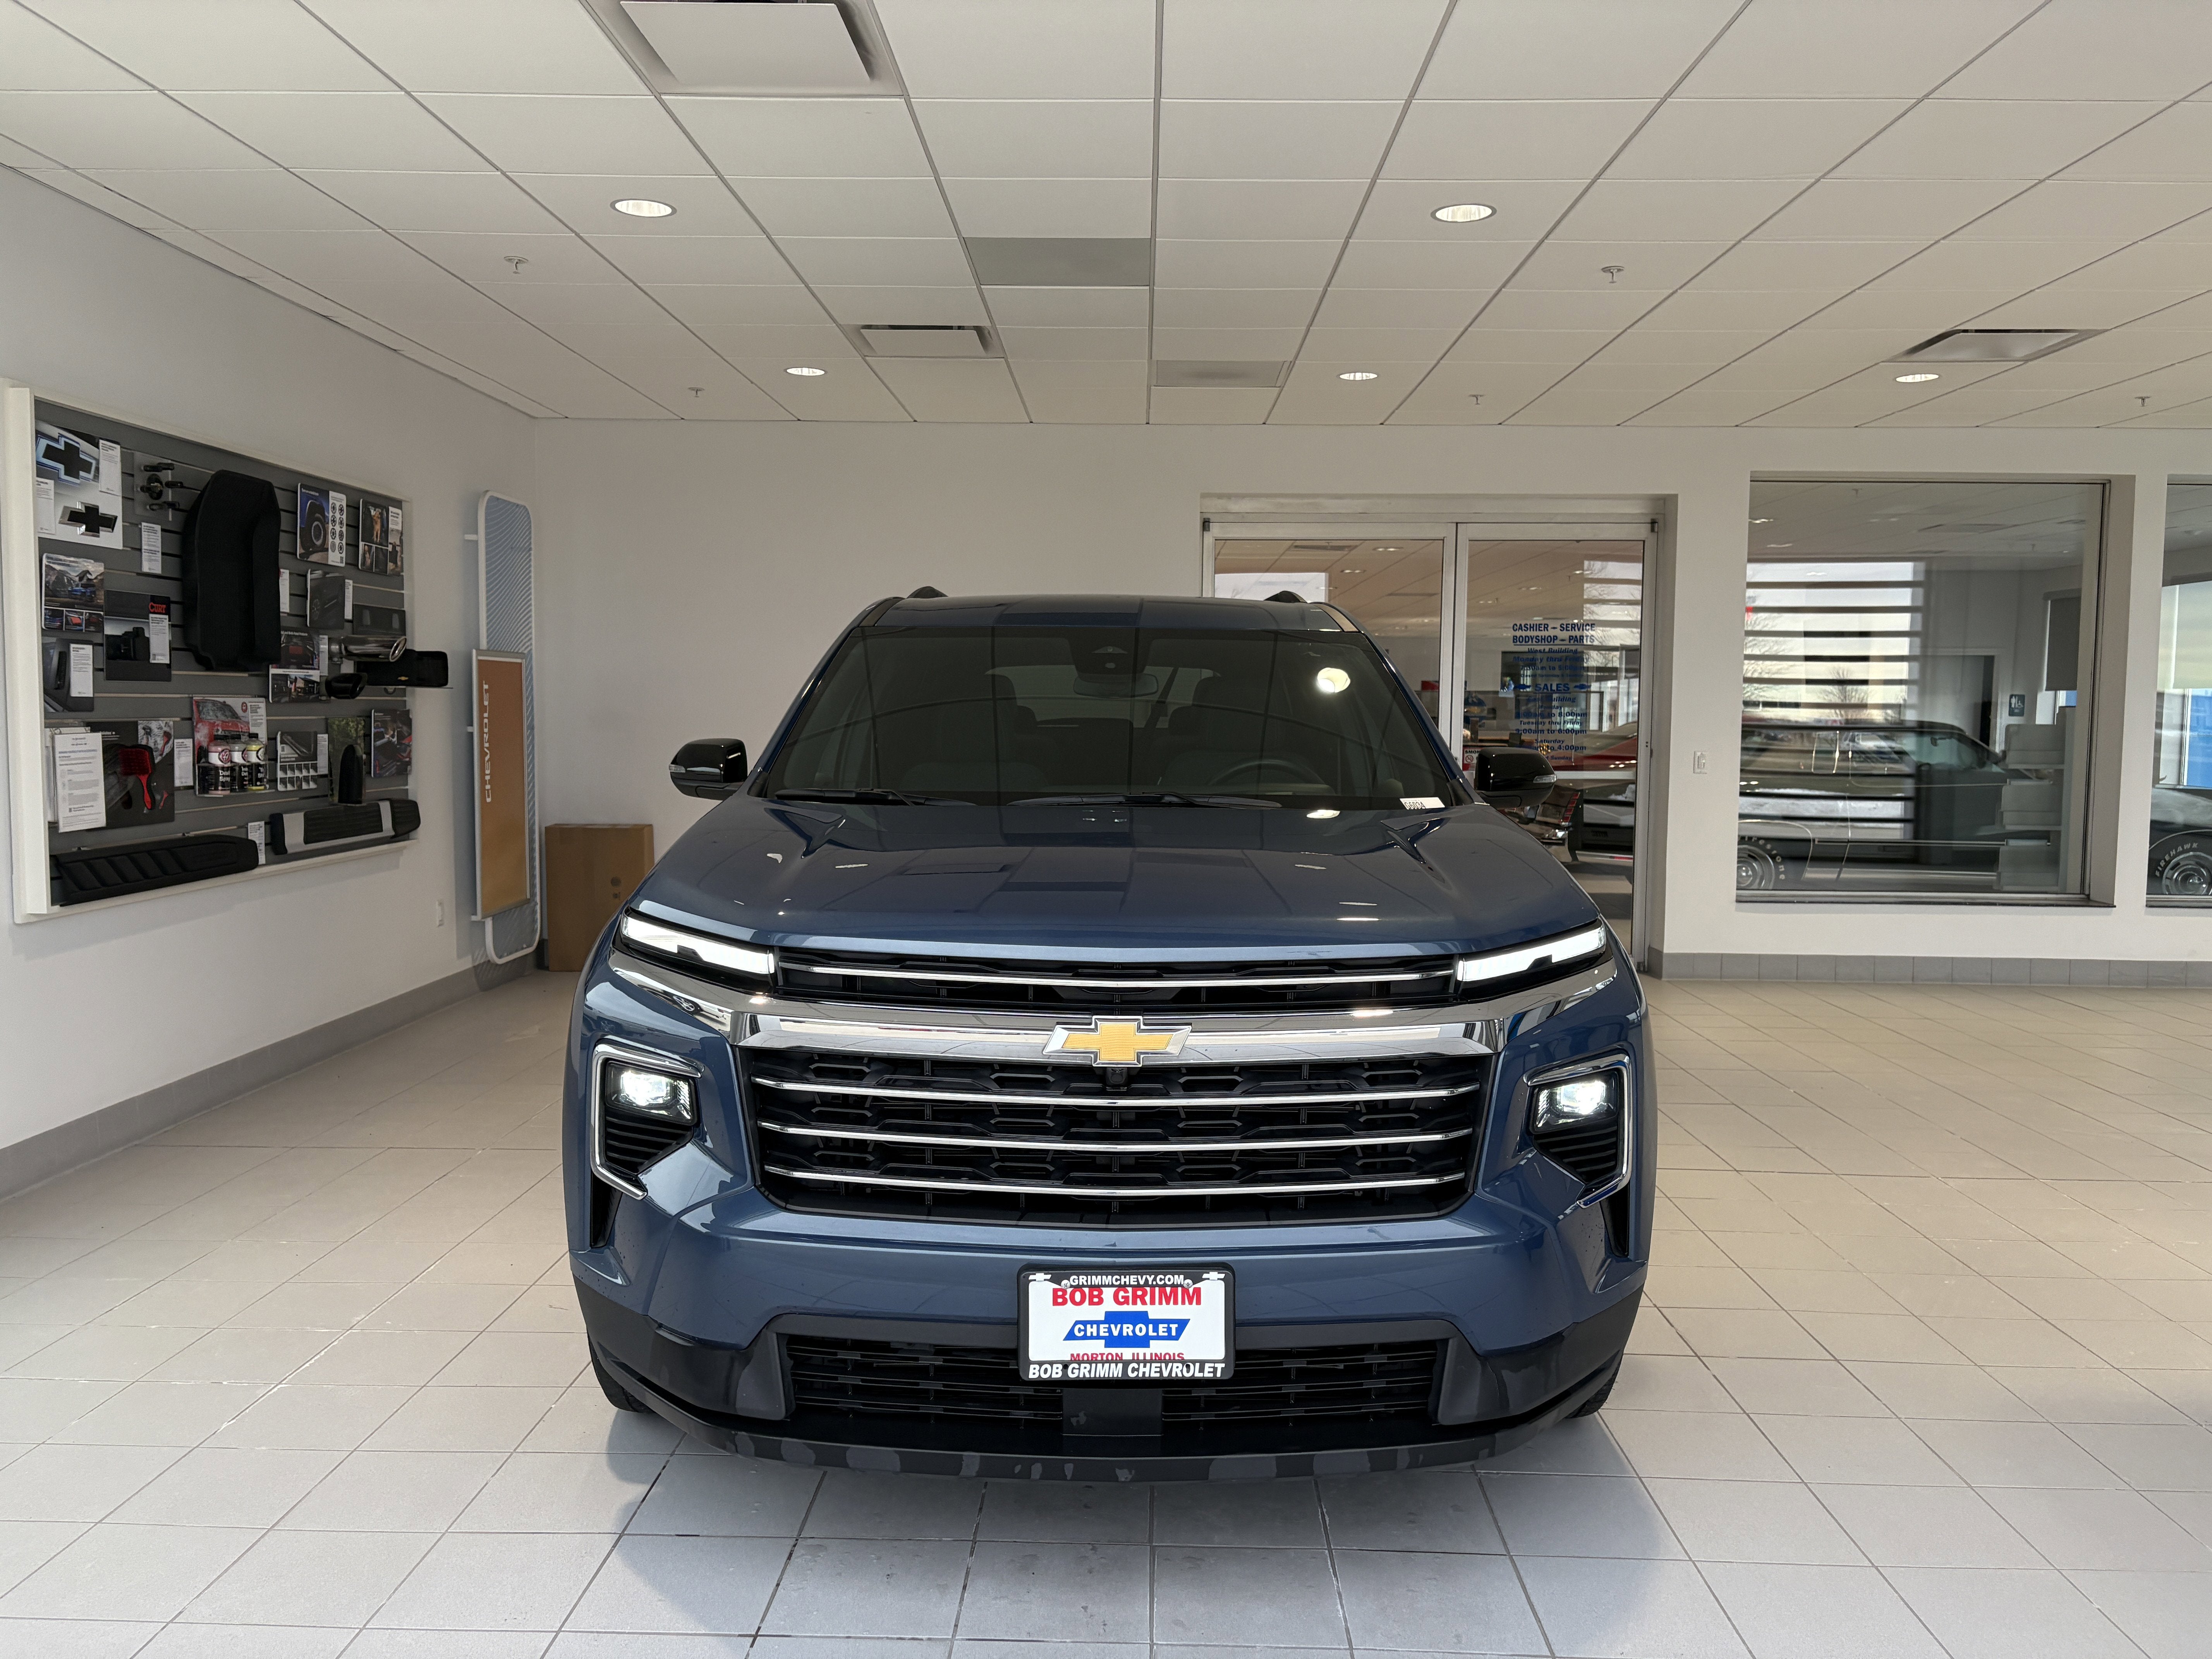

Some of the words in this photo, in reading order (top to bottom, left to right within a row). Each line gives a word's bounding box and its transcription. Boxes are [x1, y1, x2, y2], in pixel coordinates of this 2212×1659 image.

[1512, 623, 1549, 632] CASHIER
[1559, 623, 1595, 632] SERVICE
[1513, 635, 1558, 643] BODYSHOP
[1569, 635, 1595, 643] PARTS
[1535, 683, 1570, 692] SALES
[483, 680, 491, 803] CHEVROLET
[1739, 835, 1785, 880] irestone
[2155, 843, 2198, 877] FIREHAWK
[1070, 1275, 1184, 1286] GRIMMCHEVY.COM
[1052, 1287, 1104, 1306] BOB
[1113, 1287, 1201, 1306] GRIMM
[1074, 1323, 1178, 1336] CHEVROLET
[1070, 1353, 1123, 1361] MORTON
[1029, 1364, 1063, 1379] BOB
[1067, 1363, 1123, 1378] GRIMM
[1127, 1362, 1225, 1378] CHEVROLET
